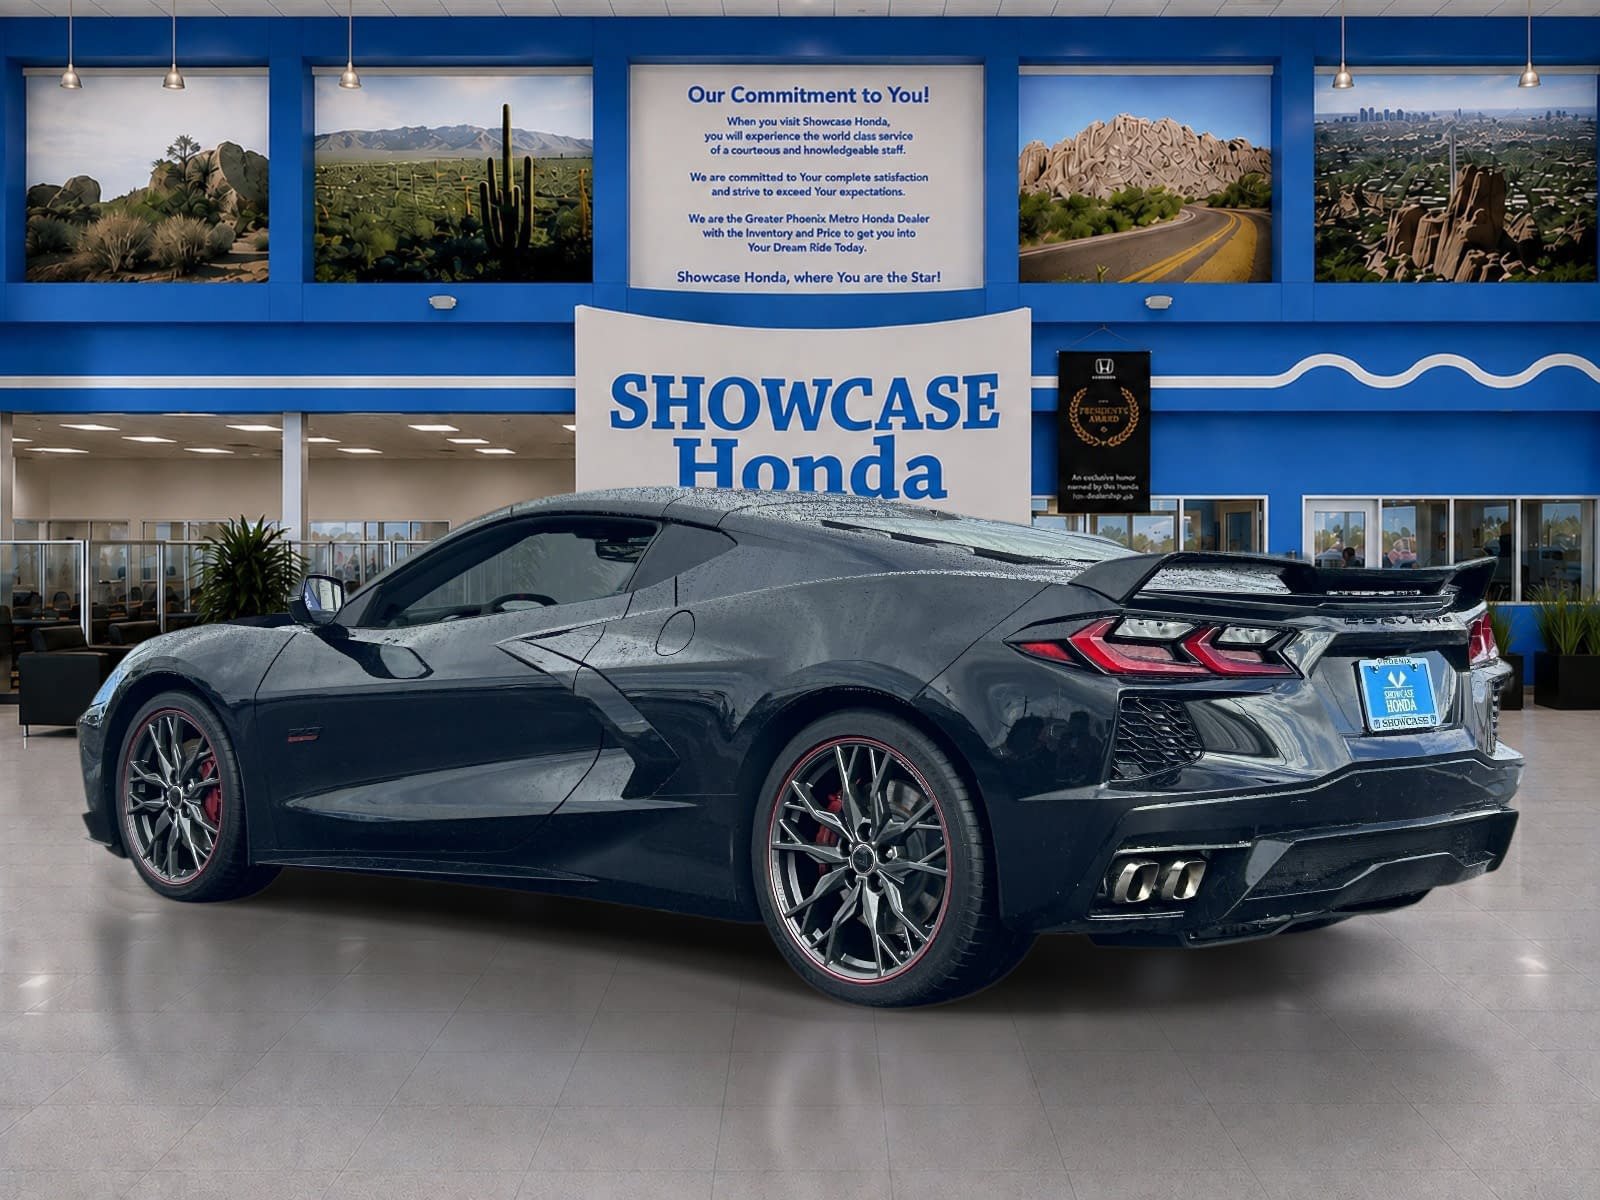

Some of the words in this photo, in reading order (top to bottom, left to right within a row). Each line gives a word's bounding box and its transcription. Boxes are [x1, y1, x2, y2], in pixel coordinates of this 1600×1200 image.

[687, 85, 726, 104] Our
[730, 85, 857, 104] Commitment
[861, 87, 883, 104] to
[886, 85, 930, 104] You!
[726, 116, 757, 127] When
[758, 118, 778, 129] you
[779, 116, 801, 127] visit
[802, 116, 853, 127] Showcase
[854, 116, 891, 128] Honda,
[704, 132, 724, 144] you
[725, 130, 743, 141] will
[744, 130, 801, 144] experience
[802, 130, 820, 141] the
[821, 130, 851, 142] world
[852, 130, 877, 142] class
[878, 130, 914, 142] service
[710, 144, 722, 155] of
[722, 147, 730, 155] a
[730, 146, 781, 156] courteous
[782, 144, 802, 155] and
[881, 144, 907, 155] staff.
[689, 171, 708, 183] We
[709, 174, 727, 182] are
[728, 171, 784, 183] committed
[785, 173, 798, 183] to
[799, 172, 823, 183] Your
[824, 171, 872, 185] complete
[873, 171, 929, 183] satisfaction
[711, 186, 731, 197] and
[732, 186, 761, 197] strive
[762, 187, 774, 197] to
[775, 186, 812, 197] exceed
[814, 186, 838, 197] Your
[839, 186, 906, 200] expectations.
[688, 213, 706, 225] We
[707, 215, 725, 224] are
[726, 213, 743, 224] the
[744, 213, 784, 224] Greater
[785, 213, 827, 224] Phoenix
[828, 213, 860, 224] Metro
[861, 213, 895, 224] Honda
[897, 212, 931, 224] Dealer
[702, 227, 725, 238] with
[726, 227, 744, 239] the
[745, 227, 794, 241] Inventory
[795, 227, 815, 239] and
[816, 227, 842, 239] Price
[843, 229, 855, 239] to
[856, 229, 875, 241] get
[876, 230, 895, 241] you
[896, 227, 917, 239] into
[747, 242, 772, 253] Your
[773, 242, 808, 253] Dream
[809, 242, 832, 253] Ride
[833, 242, 868, 255] Today.
[677, 270, 741, 284] Showcase
[744, 270, 790, 286] Honda,
[793, 270, 834, 284] where
[836, 271, 861, 284] You
[863, 274, 884, 284] are
[886, 270, 908, 284] the
[911, 270, 941, 284] Star!
[610, 372, 1001, 432] SHOWCASE
[673, 434, 948, 500] Honda
[1376, 657, 1413, 665] PHOENIX
[1384, 689, 1415, 699] SHOWCASE
[1386, 698, 1418, 713] HONDA
[1382, 716, 1430, 728] SHOWCASE
